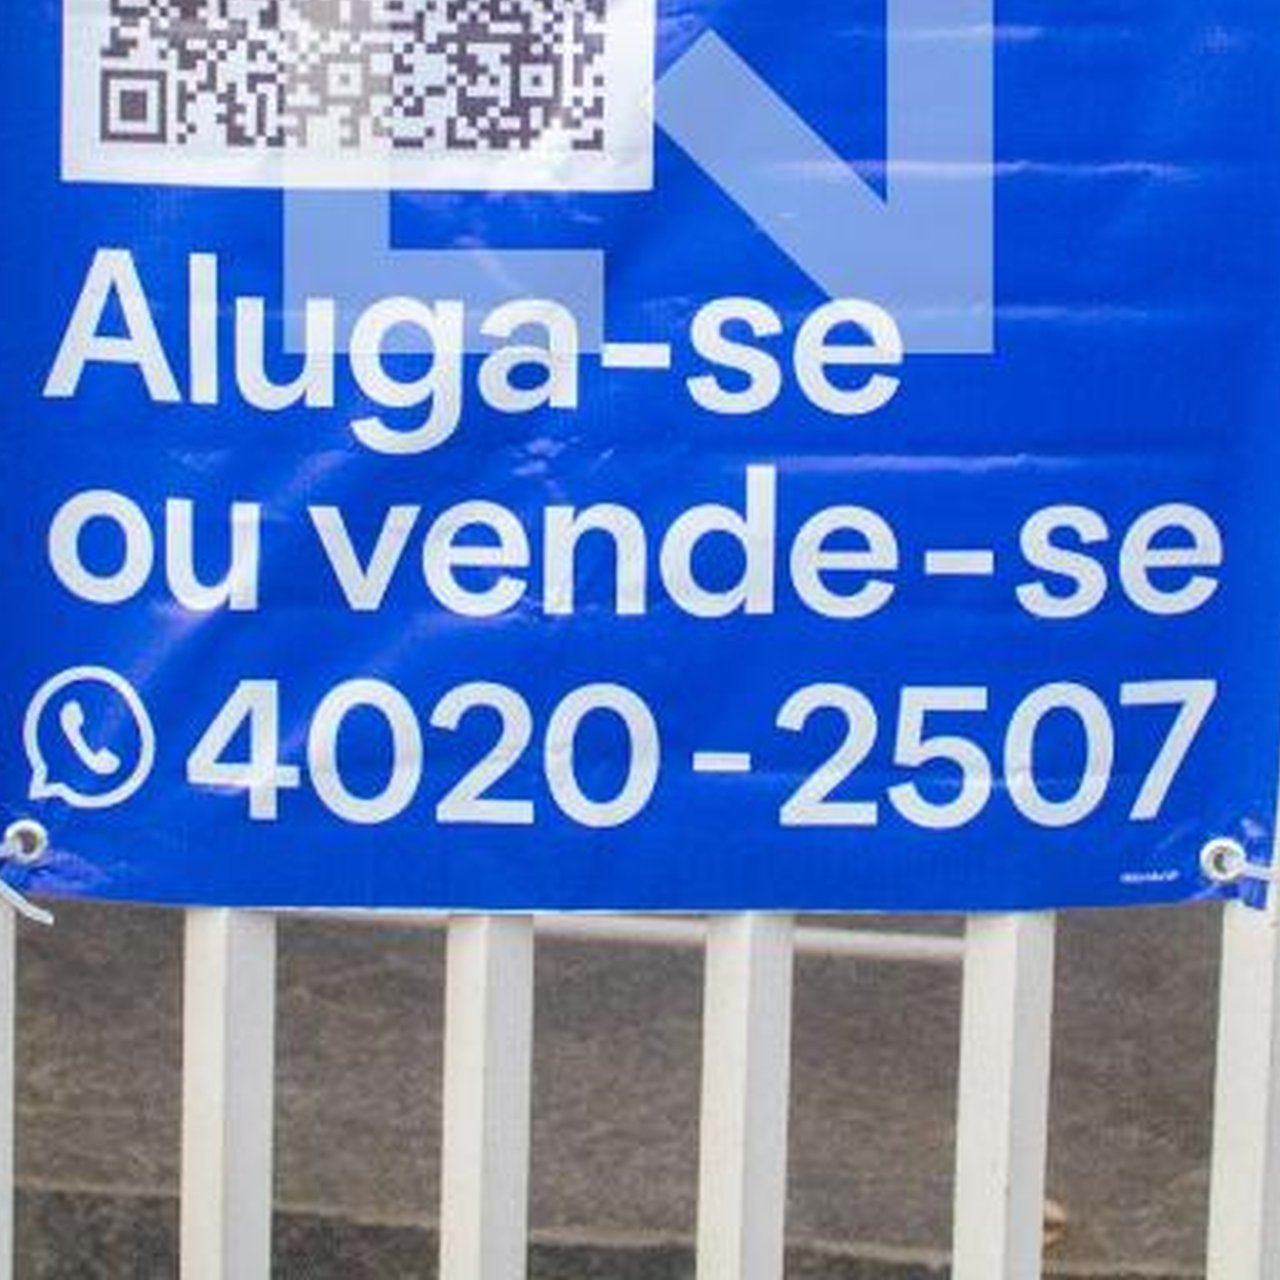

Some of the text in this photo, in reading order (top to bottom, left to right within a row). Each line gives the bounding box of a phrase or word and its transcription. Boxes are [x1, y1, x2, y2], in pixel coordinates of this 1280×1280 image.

[41, 247, 904, 455] Aluga-se
[47, 464, 1224, 620] ou vende-se
